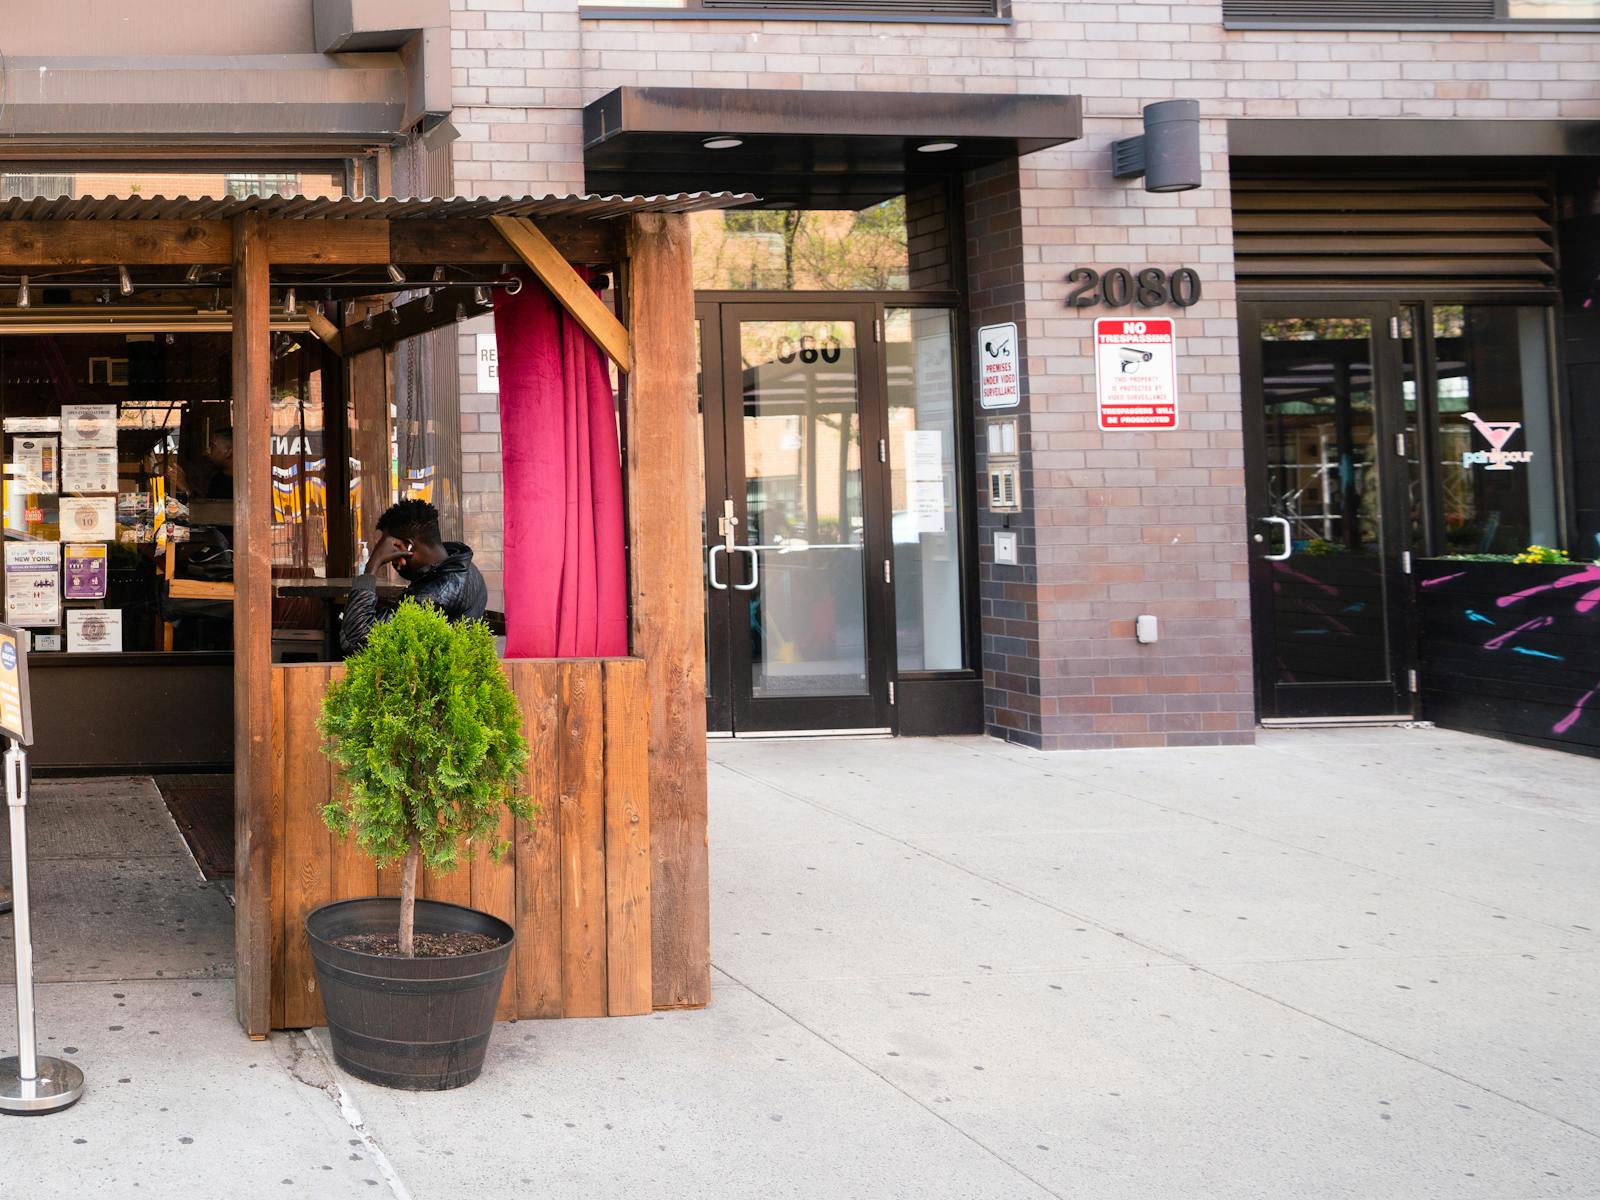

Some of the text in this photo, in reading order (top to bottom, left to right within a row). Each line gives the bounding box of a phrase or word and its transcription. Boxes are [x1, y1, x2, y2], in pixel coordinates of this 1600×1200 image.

[1067, 267, 1201, 307] 2080
[1123, 322, 1147, 334] NO
[1099, 334, 1171, 343] TRESPASSING
[986, 362, 1011, 373] PREMISES
[984, 374, 1015, 385] UNDER VIDEO
[984, 386, 1016, 397] SURVEILLANCE
